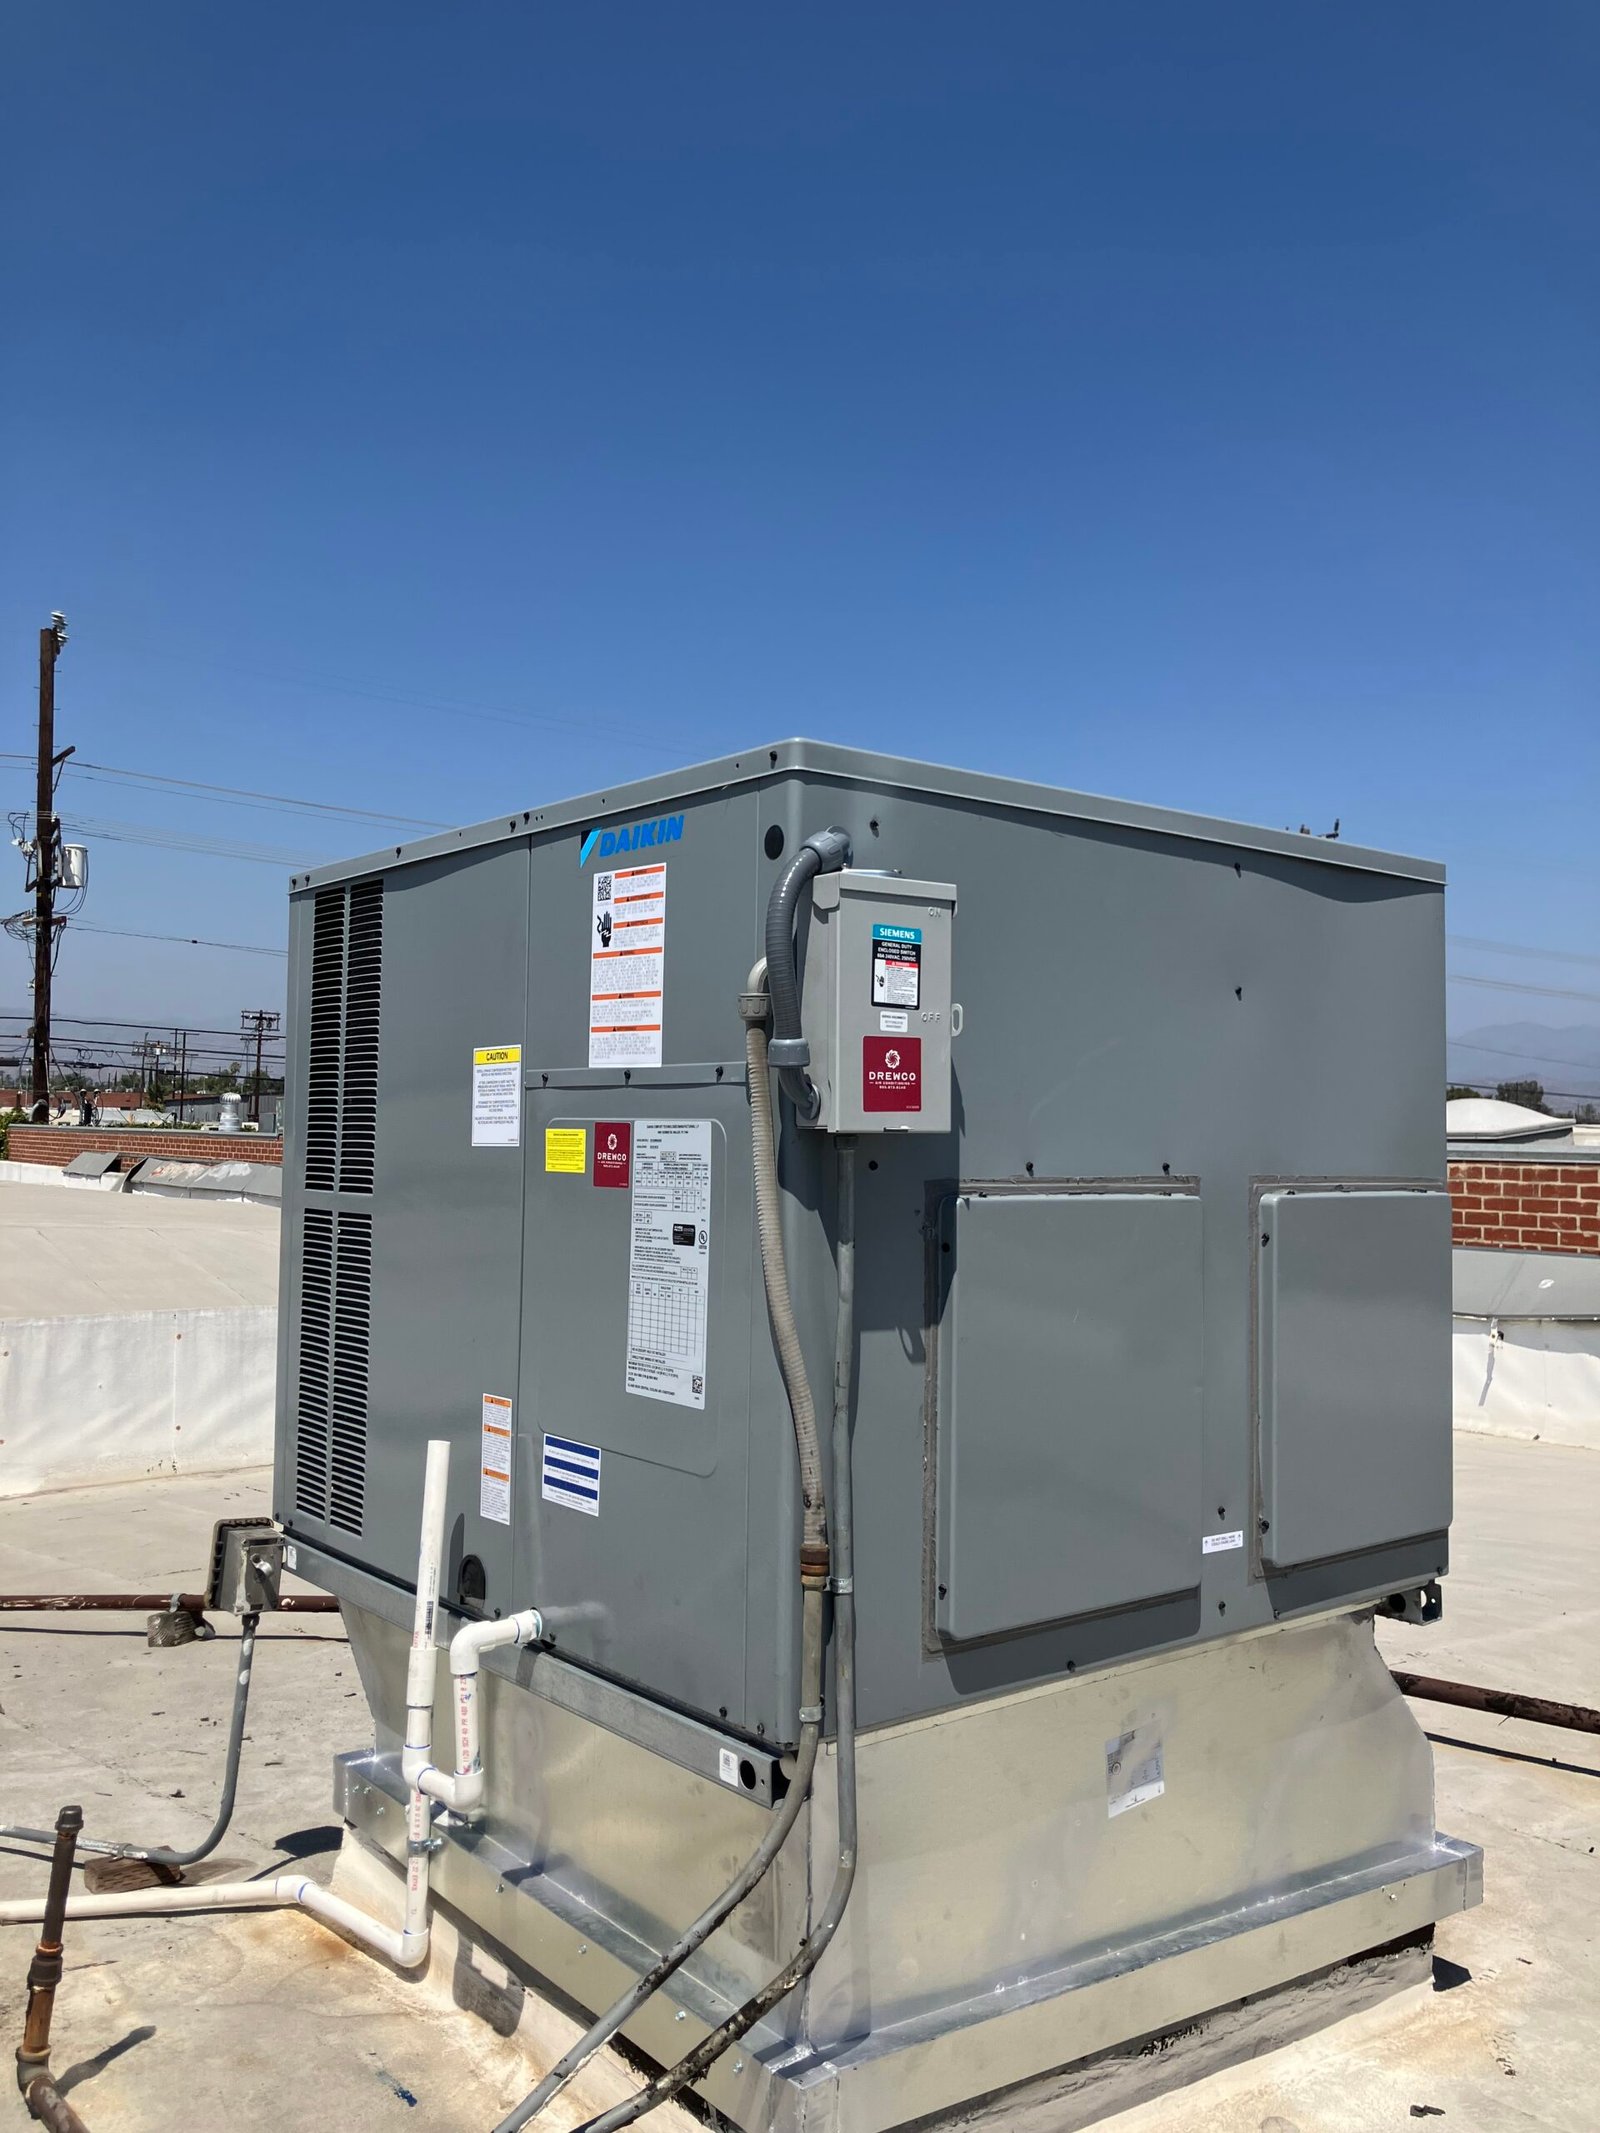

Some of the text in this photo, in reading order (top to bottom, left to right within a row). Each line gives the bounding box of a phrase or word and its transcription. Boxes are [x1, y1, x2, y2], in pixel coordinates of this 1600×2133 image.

[599, 815, 685, 858] DAIKIN
[927, 906, 941, 918] ON
[880, 928, 915, 940] SIEMENS
[881, 941, 901, 949] GENERAL
[921, 1012, 941, 1023] OFF
[486, 1051, 509, 1062] CAUTION
[869, 1071, 916, 1081] DREWCO
[597, 1152, 627, 1162] DREWCO
